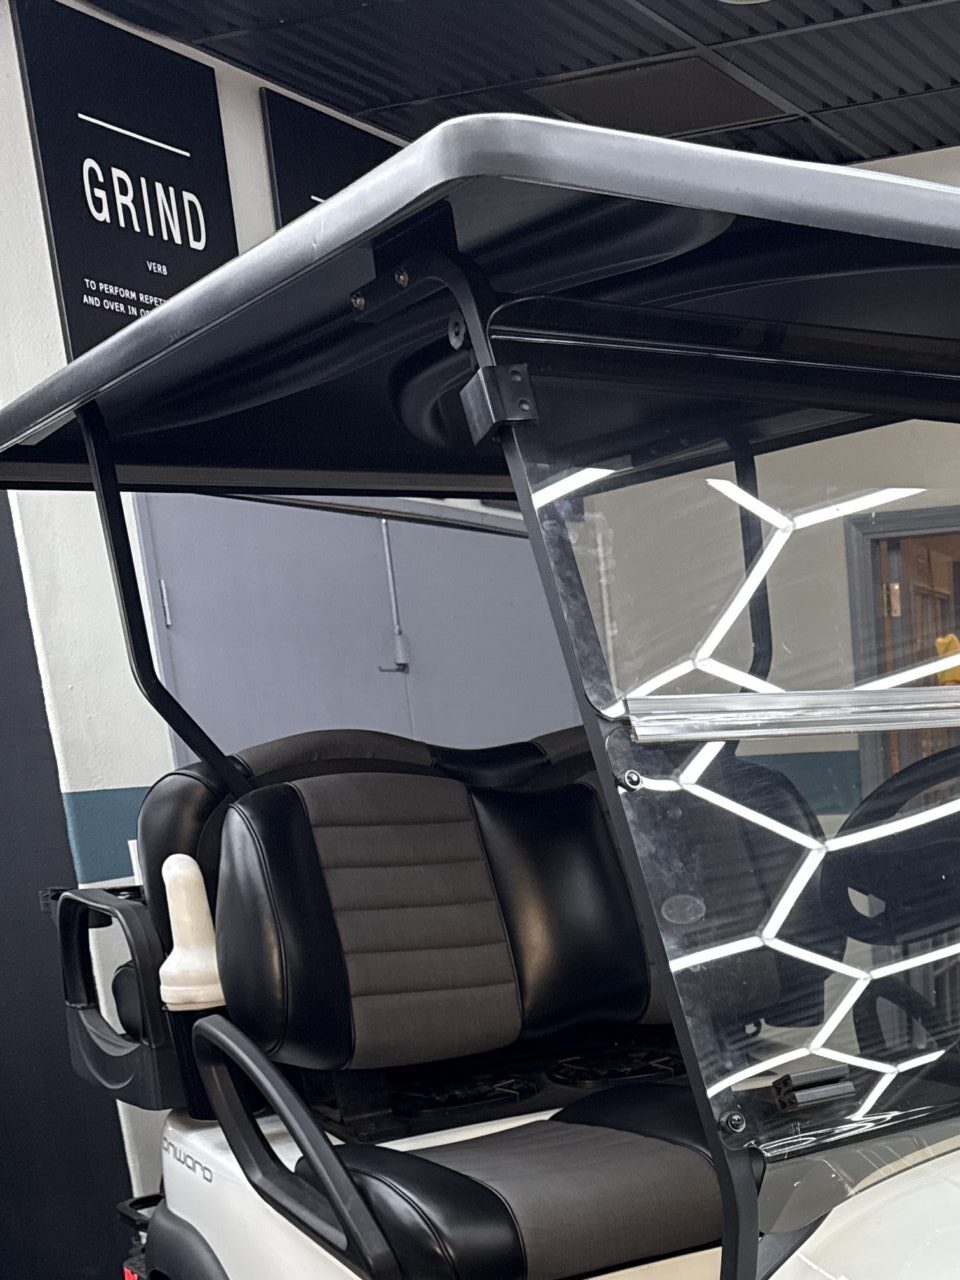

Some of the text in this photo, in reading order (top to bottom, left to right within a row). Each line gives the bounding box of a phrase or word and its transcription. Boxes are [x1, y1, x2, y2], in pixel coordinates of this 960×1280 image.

[82, 157, 206, 251] GRIND
[146, 260, 168, 276] VERB
[84, 278, 97, 291] TO
[99, 282, 137, 301] PERFORM
[83, 294, 101, 308] AND
[103, 299, 126, 314] OVER
[127, 305, 138, 317] IN
